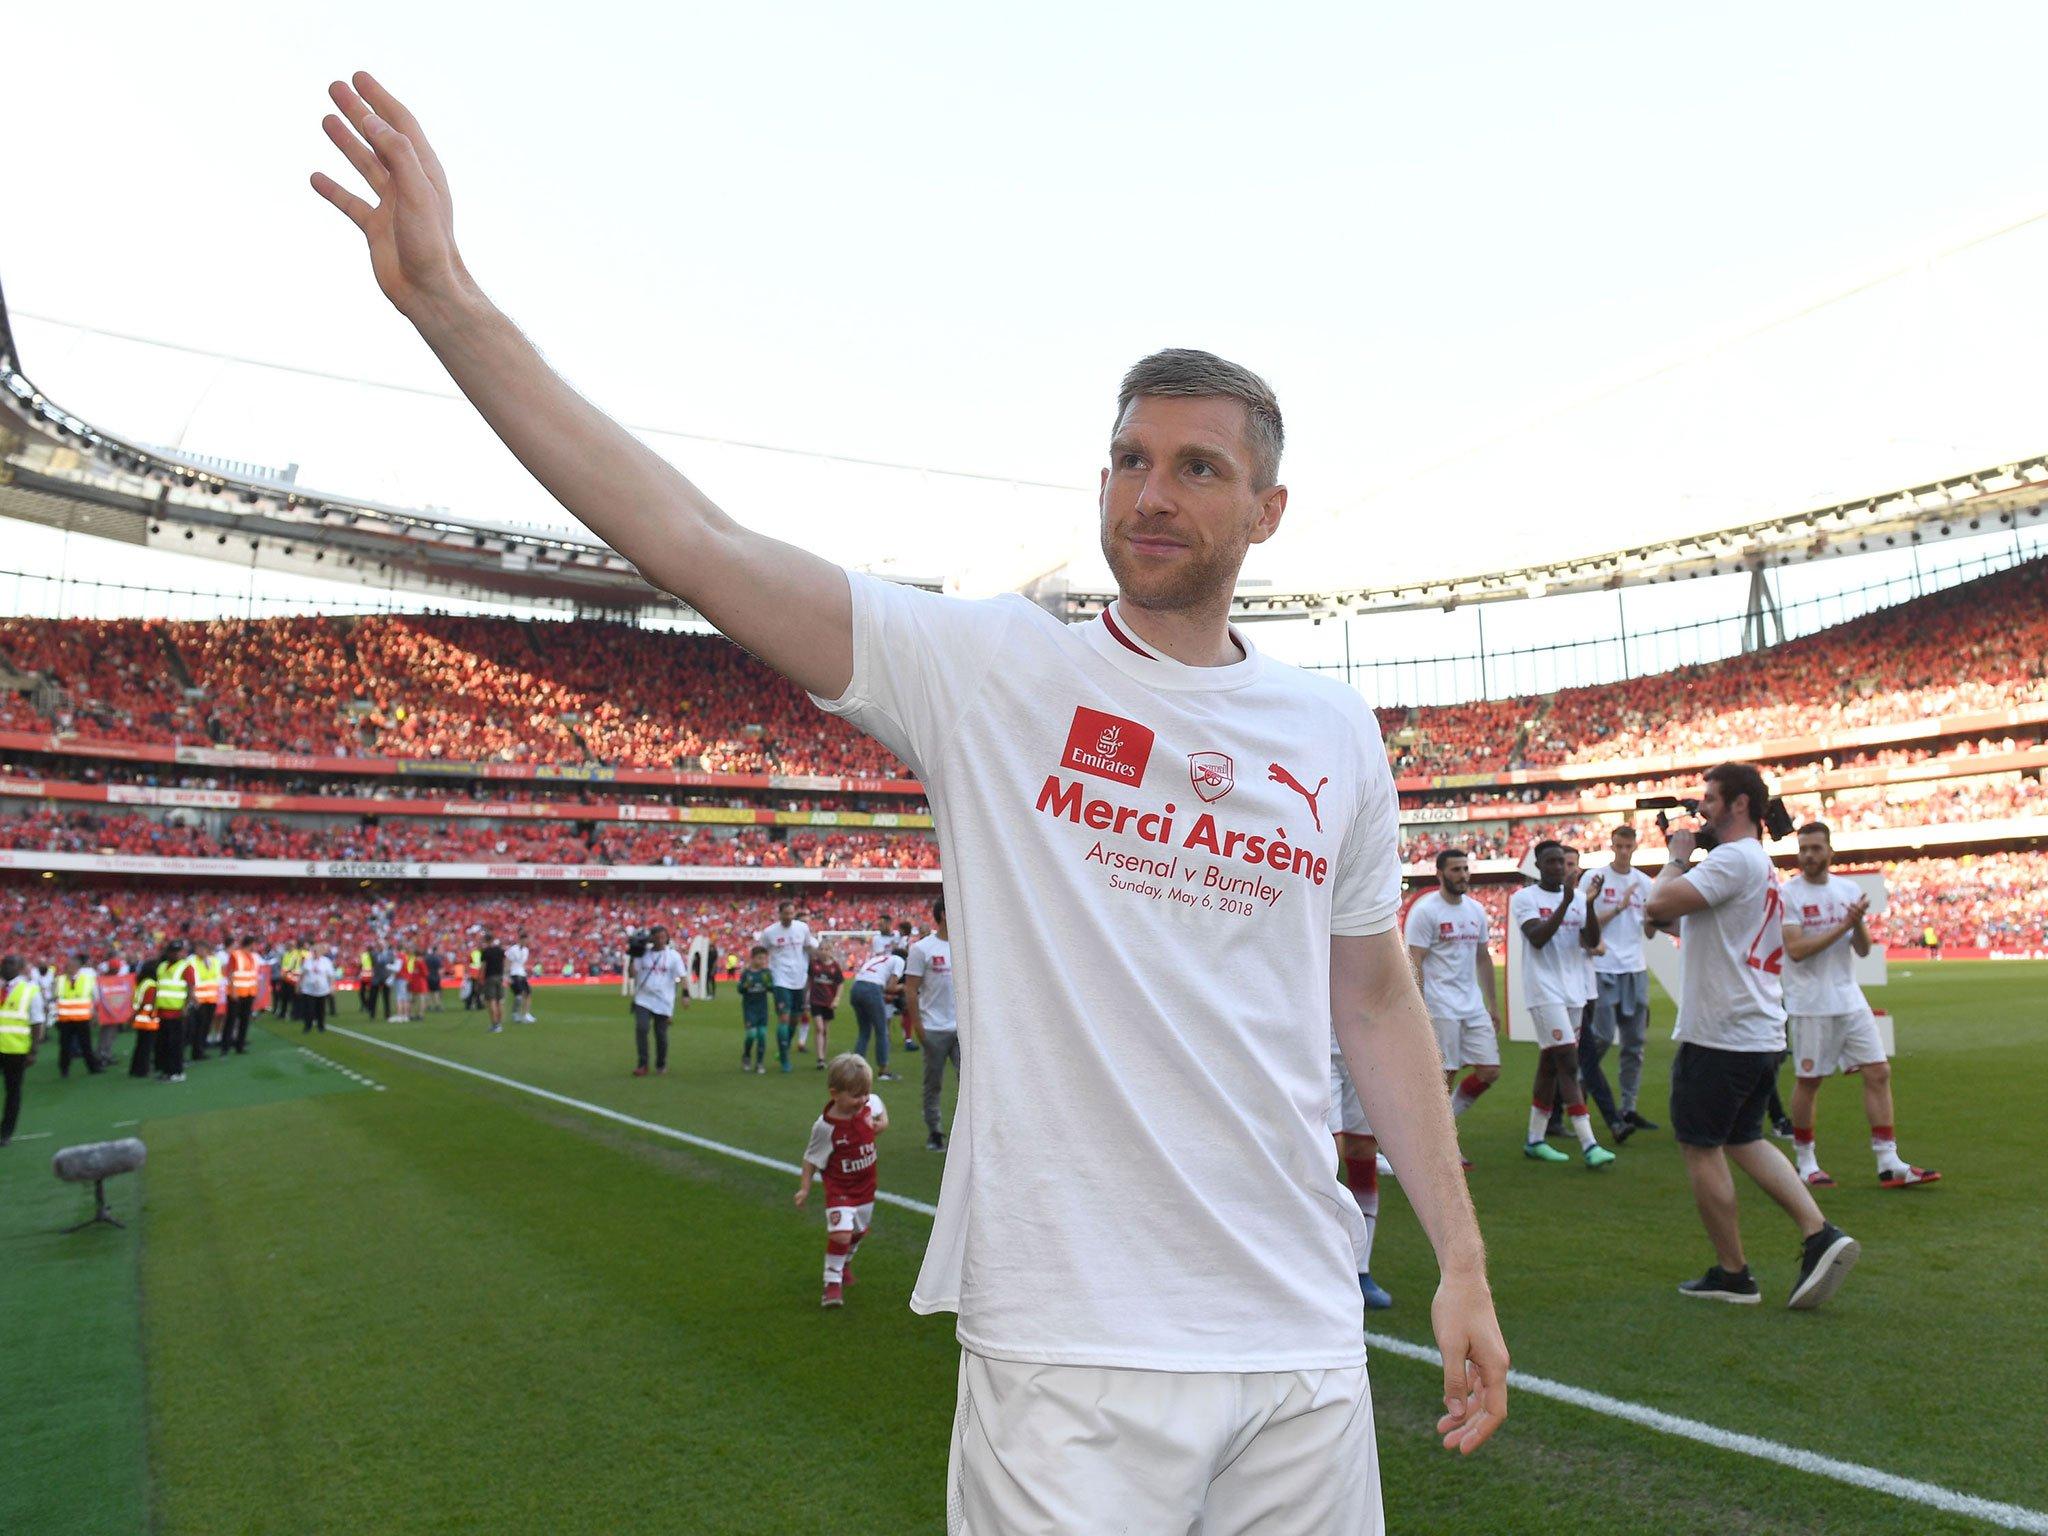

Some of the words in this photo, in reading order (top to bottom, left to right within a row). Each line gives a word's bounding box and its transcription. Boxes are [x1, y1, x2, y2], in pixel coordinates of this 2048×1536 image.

[1072, 748, 1135, 777] Emirates
[1035, 774, 1177, 844] Merci
[1183, 813, 1328, 886] Arsène
[328, 863, 407, 876] GATORADE
[1085, 841, 1178, 879] Arsenal
[1184, 868, 1197, 882] v
[1203, 865, 1283, 907] Burnley
[1109, 875, 1162, 899] Sunday,
[1167, 887, 1198, 907] May
[1201, 896, 1214, 910] 6,
[1219, 898, 1253, 917] 2018
